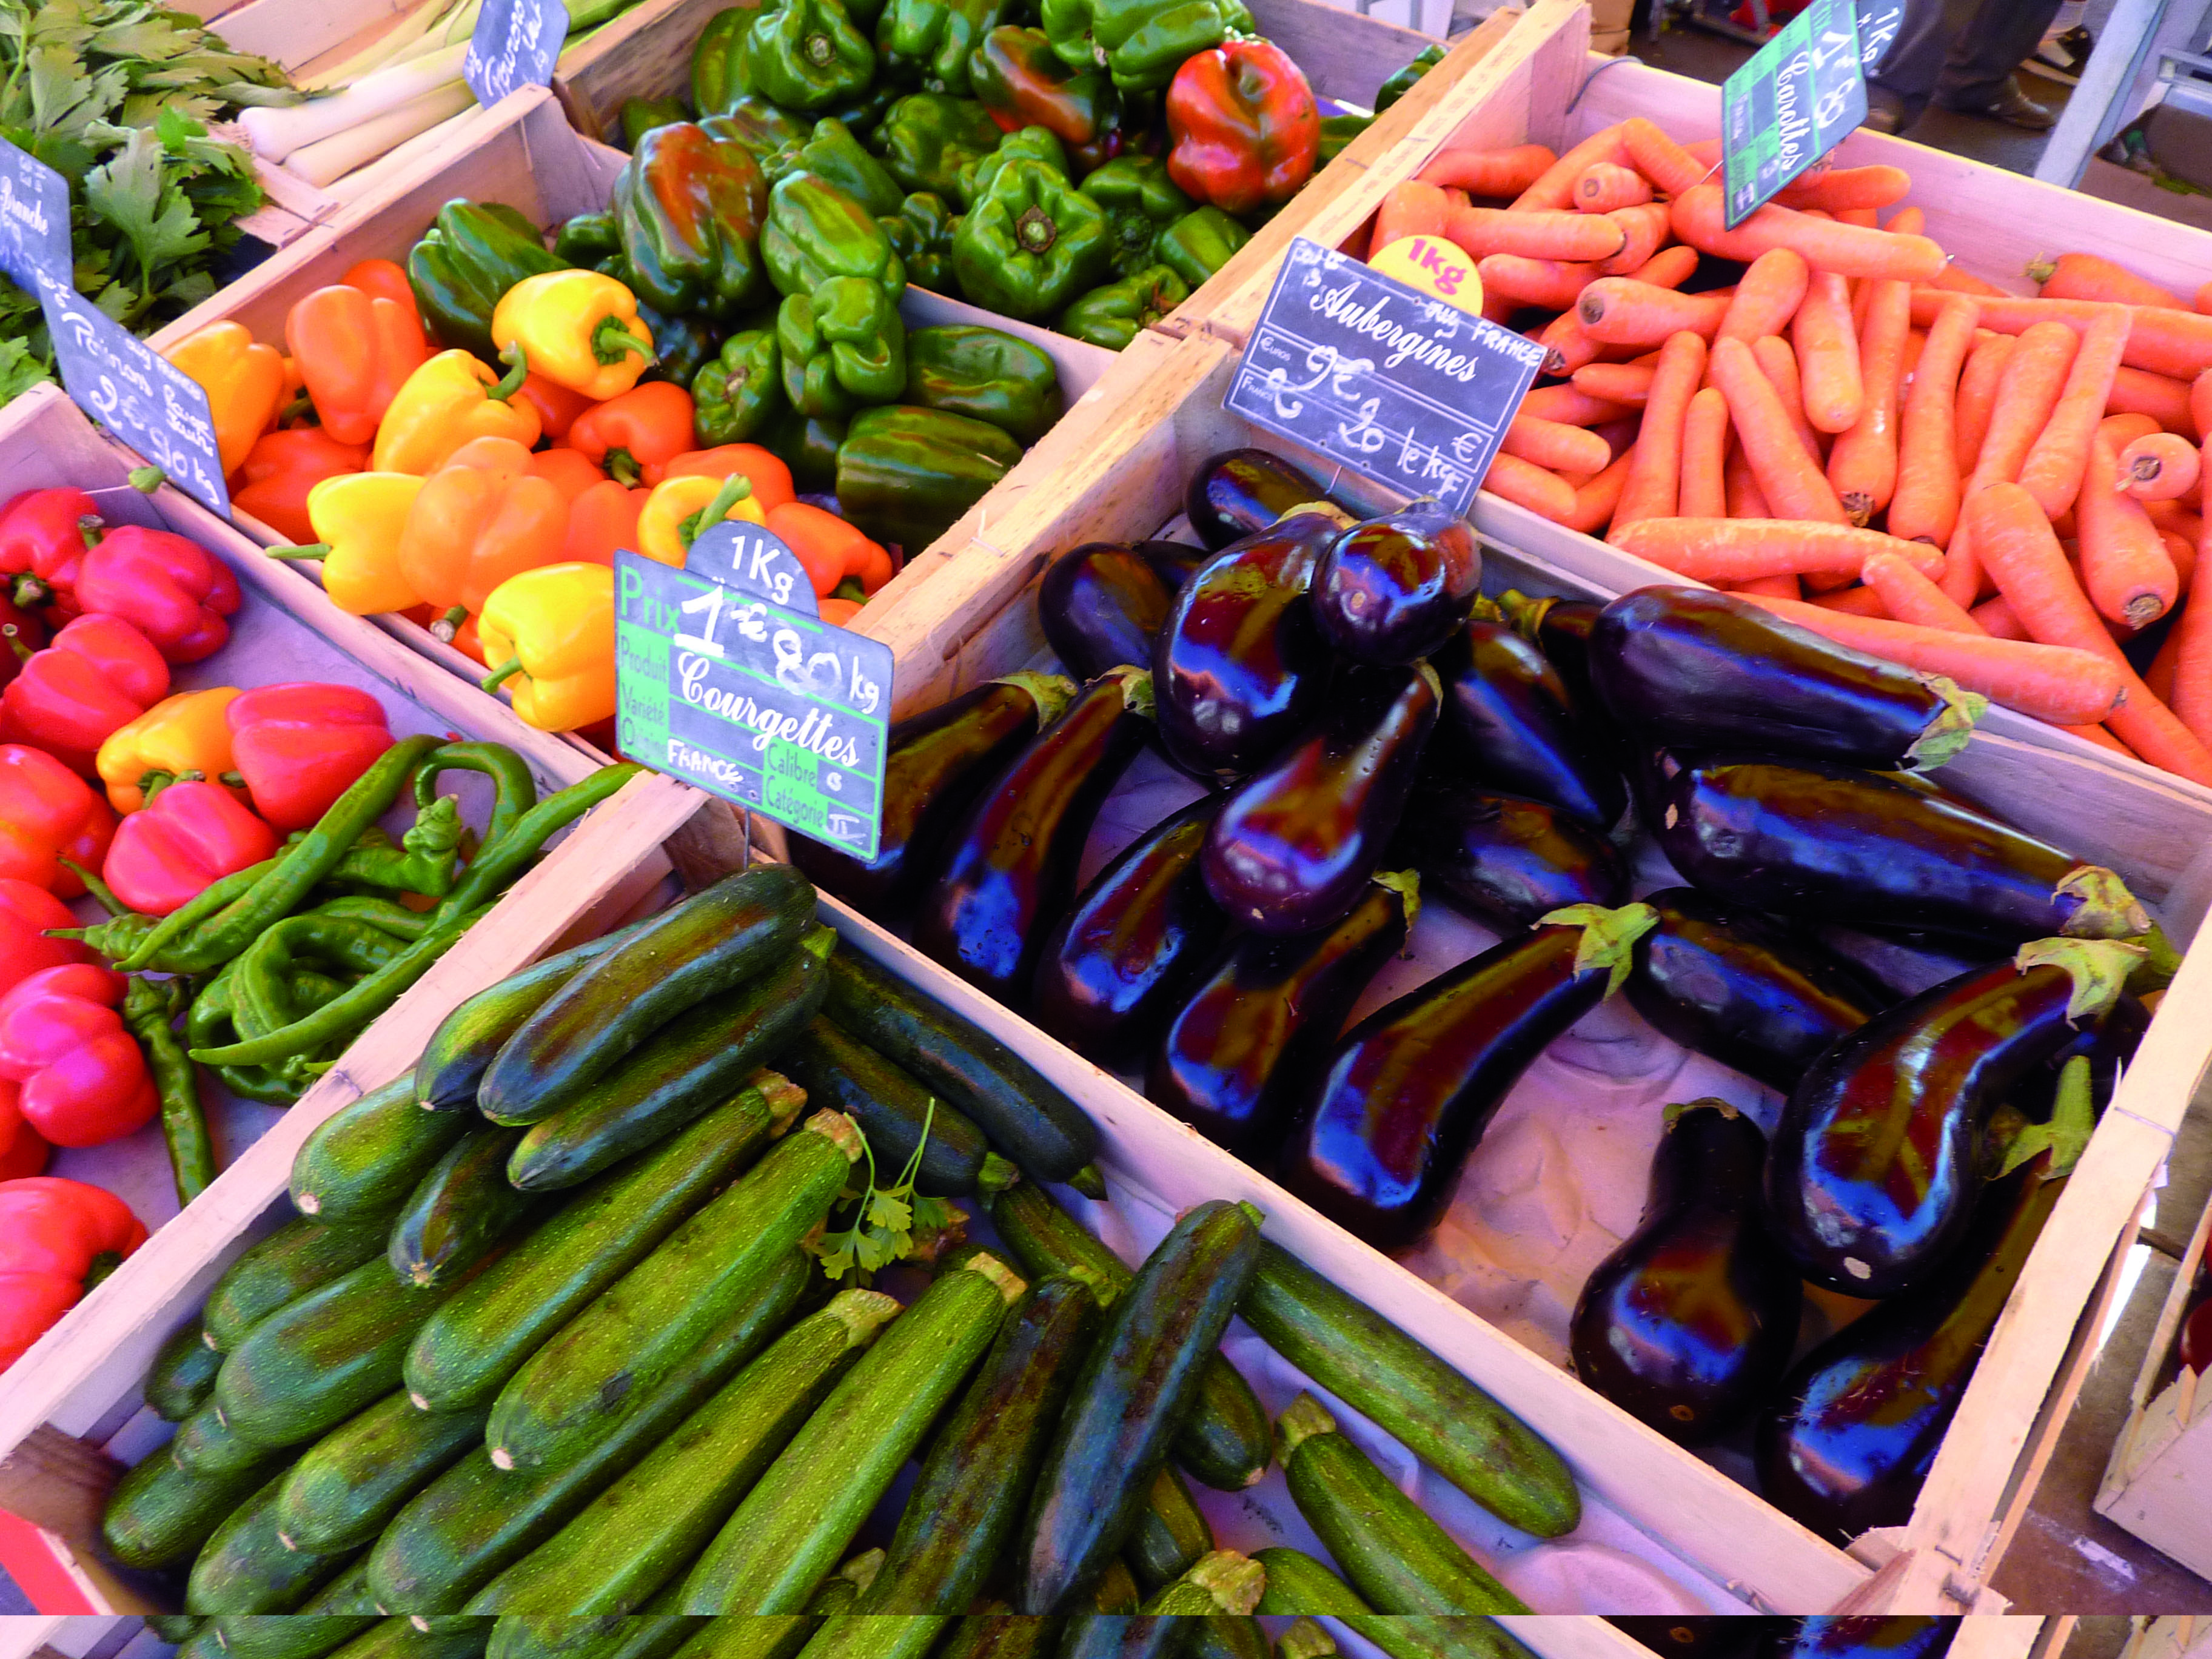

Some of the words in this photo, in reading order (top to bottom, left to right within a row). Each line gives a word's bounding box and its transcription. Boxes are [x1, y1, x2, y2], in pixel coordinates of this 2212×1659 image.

[1776, 50, 1810, 171] Carottes
[1408, 238, 1467, 296] 1kg
[1309, 280, 1480, 383] Aubergines
[1470, 320, 1544, 367] FRANCE
[1450, 432, 1484, 463] €
[620, 564, 681, 634] Prix
[850, 655, 880, 714] kg
[620, 634, 668, 684] Produit
[621, 681, 666, 726] Variété
[677, 651, 860, 767] Courgettes
[767, 743, 817, 788] Calibre
[766, 774, 825, 825] Catégorie
